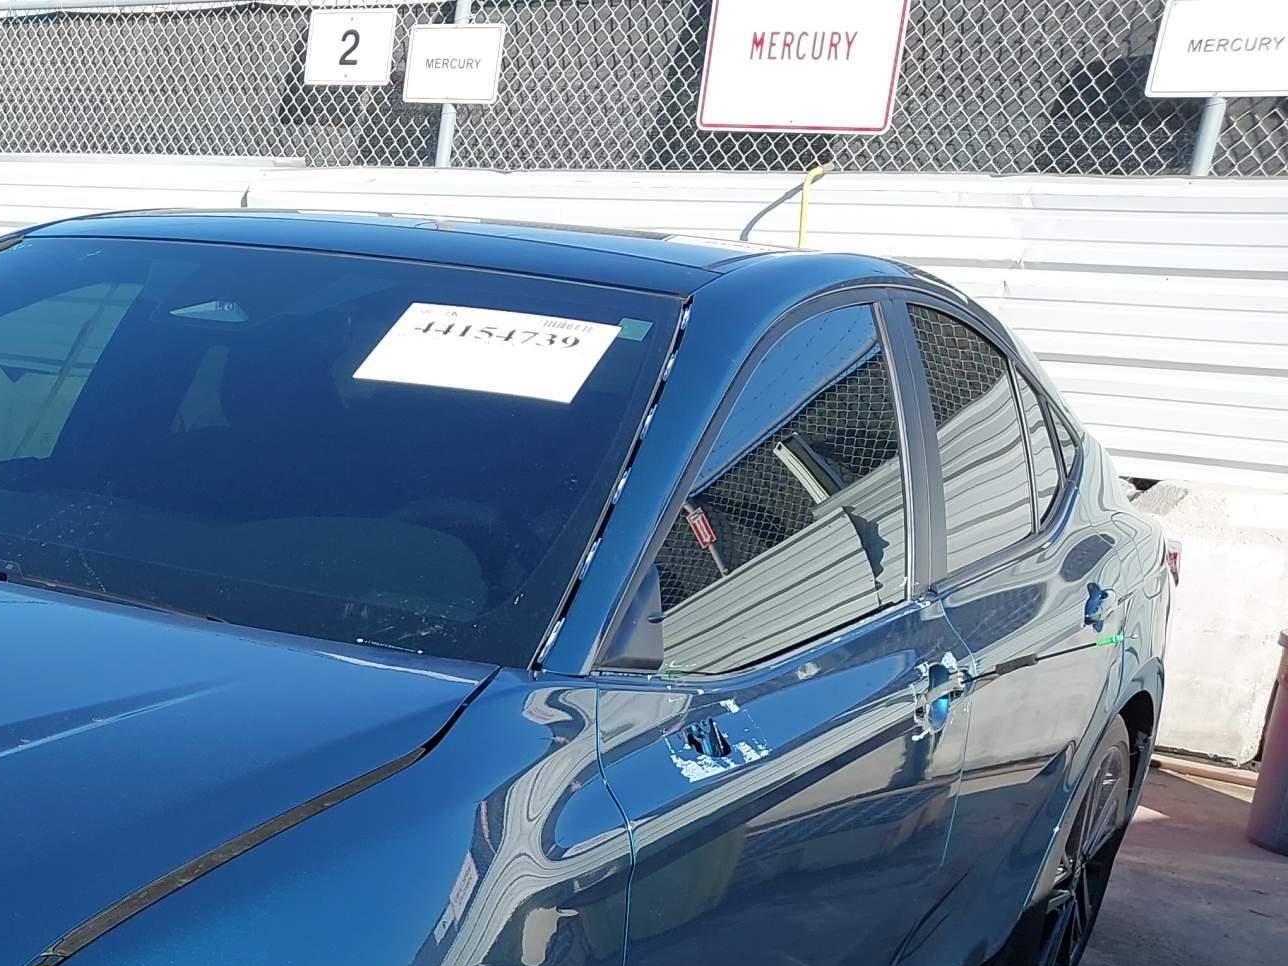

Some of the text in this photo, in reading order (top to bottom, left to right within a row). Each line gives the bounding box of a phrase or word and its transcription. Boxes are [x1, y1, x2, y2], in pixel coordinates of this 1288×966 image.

[338, 29, 360, 66] 2
[749, 31, 859, 61] MERCURY
[1187, 36, 1286, 53] MERCURY
[425, 58, 481, 70] MERCURY
[414, 320, 581, 349] 44154739
